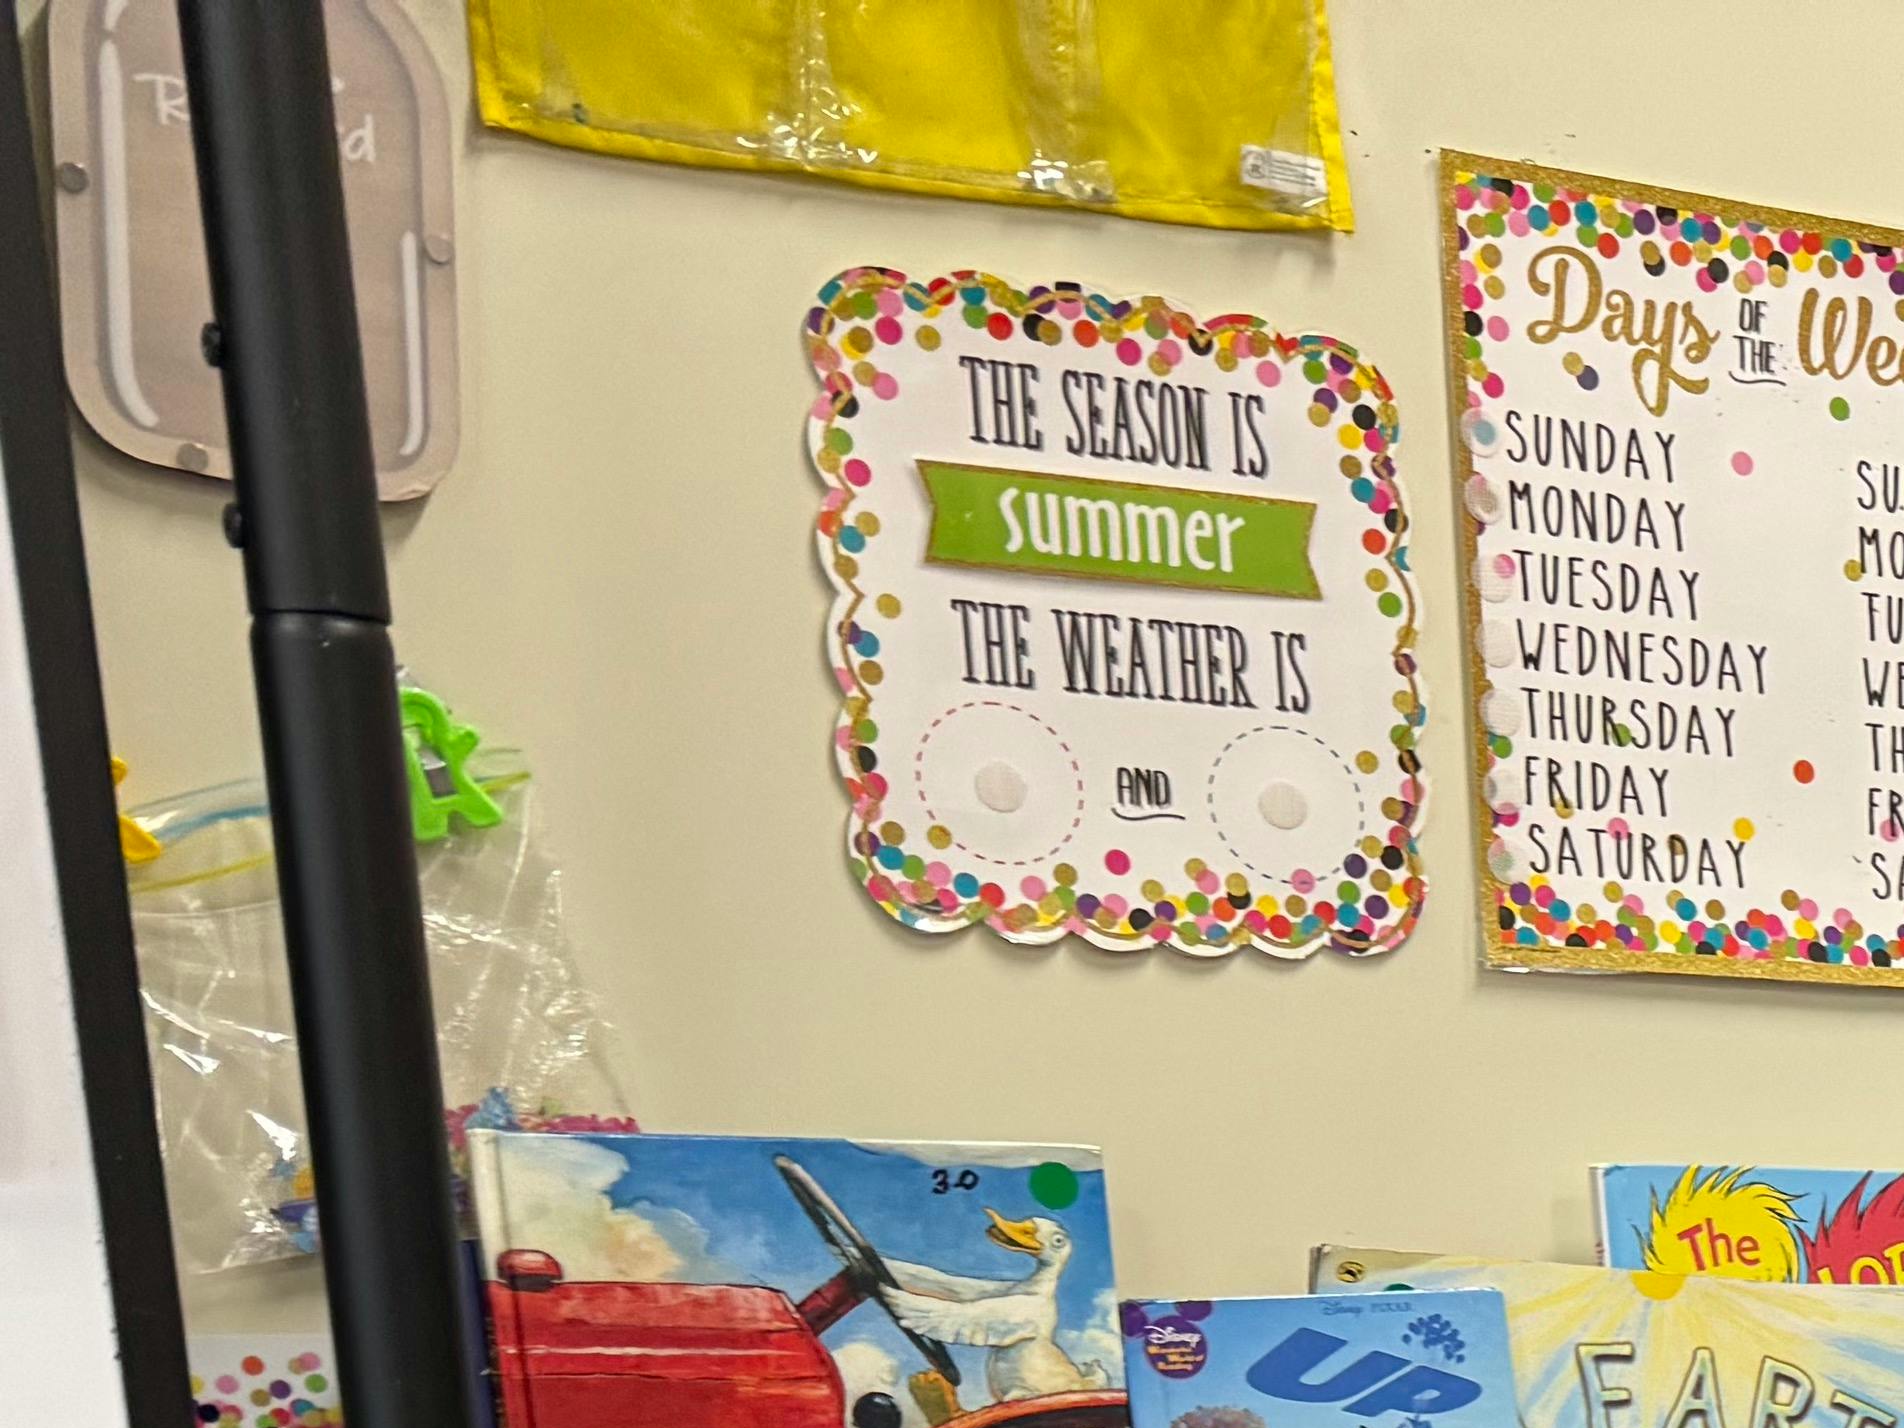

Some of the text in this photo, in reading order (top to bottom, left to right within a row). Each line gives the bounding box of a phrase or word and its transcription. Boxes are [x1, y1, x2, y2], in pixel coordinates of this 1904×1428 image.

[1526, 246, 1721, 418] Days
[1739, 298, 1768, 333] OF
[1733, 335, 1778, 376] THE
[959, 355, 1269, 480] THE SEASON IS
[1505, 410, 1676, 484] SUNDAY
[998, 487, 1246, 573] summer
[1509, 480, 1685, 553] MONDAY
[1511, 550, 1700, 622] TUESDAY
[951, 600, 1311, 715] THE WEATHER IS
[1516, 618, 1767, 696] WEDNESDAY
[1519, 688, 1736, 758] THURSDAY
[1117, 766, 1171, 808] AND
[1525, 757, 1669, 818] FRIDAY
[1528, 825, 1747, 890] SATURDAY
[1677, 1217, 1760, 1271] The
[1244, 1325, 1481, 1418] UP
